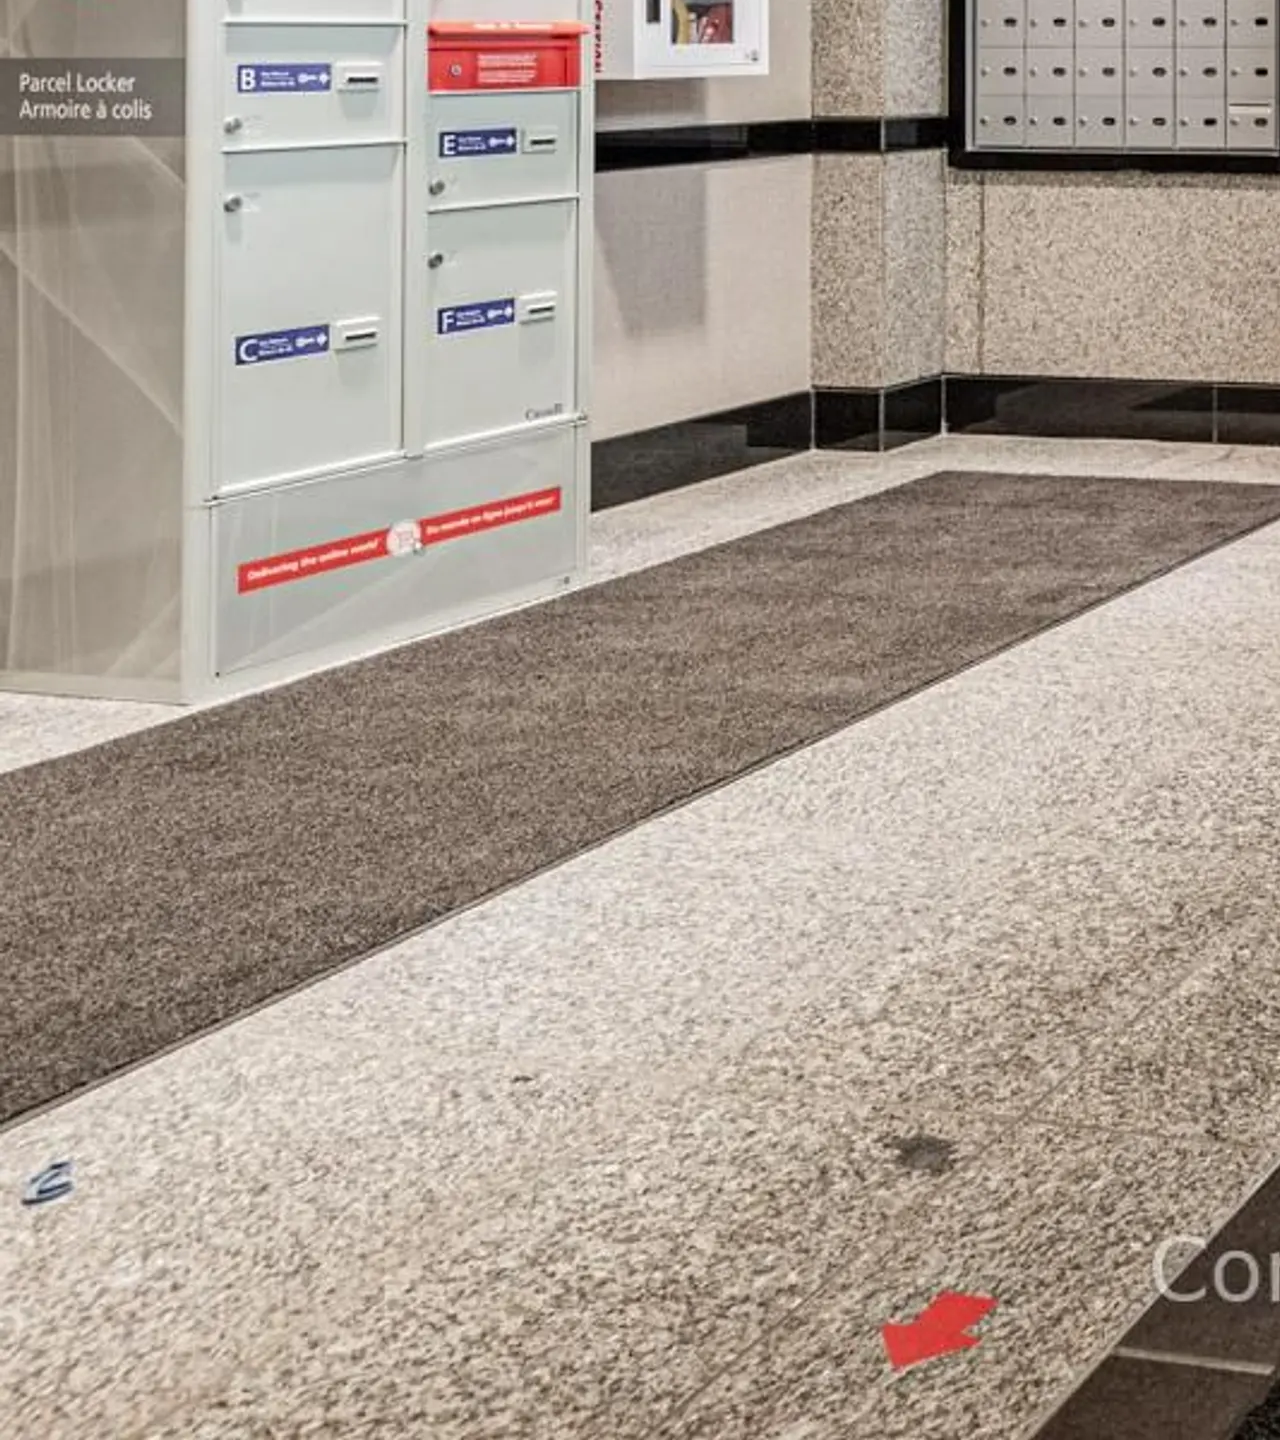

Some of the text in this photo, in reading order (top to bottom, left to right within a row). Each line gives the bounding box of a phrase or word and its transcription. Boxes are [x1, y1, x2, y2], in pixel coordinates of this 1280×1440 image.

[19, 70, 136, 93] Parcel Locker
[240, 68, 256, 90] B
[19, 98, 153, 120] Armoire à colis
[443, 135, 457, 155] E
[442, 311, 455, 332] F
[239, 338, 259, 362] C
